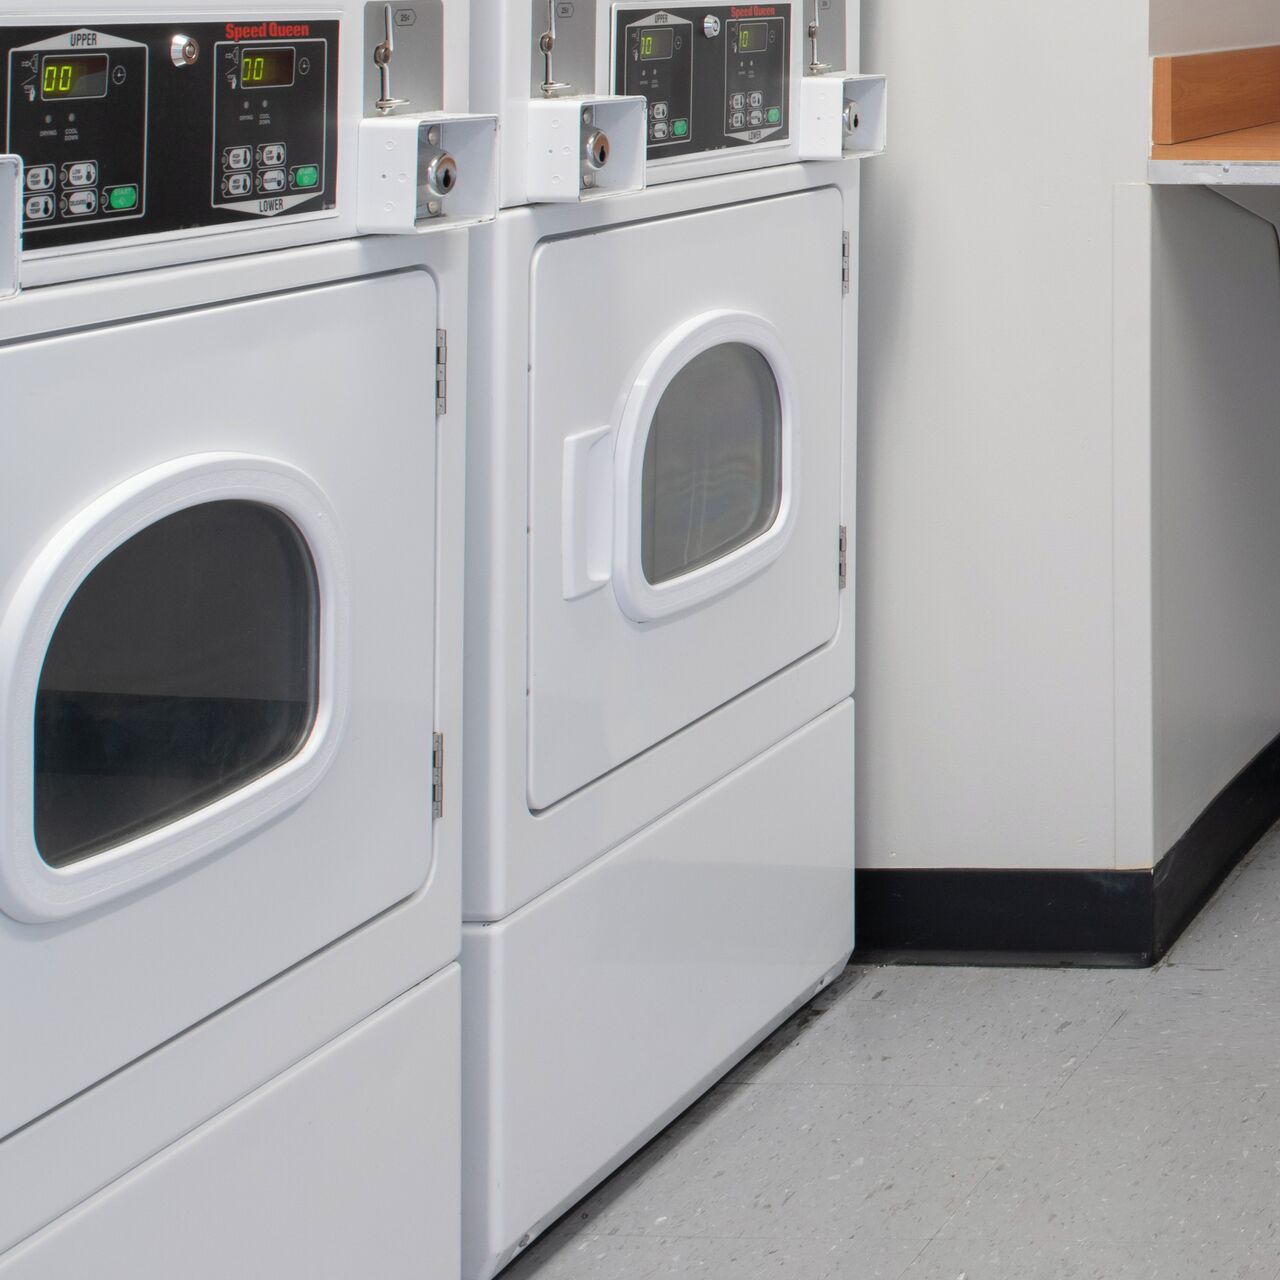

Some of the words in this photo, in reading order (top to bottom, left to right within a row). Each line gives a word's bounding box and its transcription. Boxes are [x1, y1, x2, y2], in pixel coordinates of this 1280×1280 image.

[730, 6, 753, 19] Speed
[753, 6, 775, 16] Queen
[224, 22, 267, 42] Speed
[268, 22, 309, 36] Queen
[70, 33, 97, 47] UPPER
[43, 66, 73, 91] 00
[259, 198, 284, 213] LOWER
